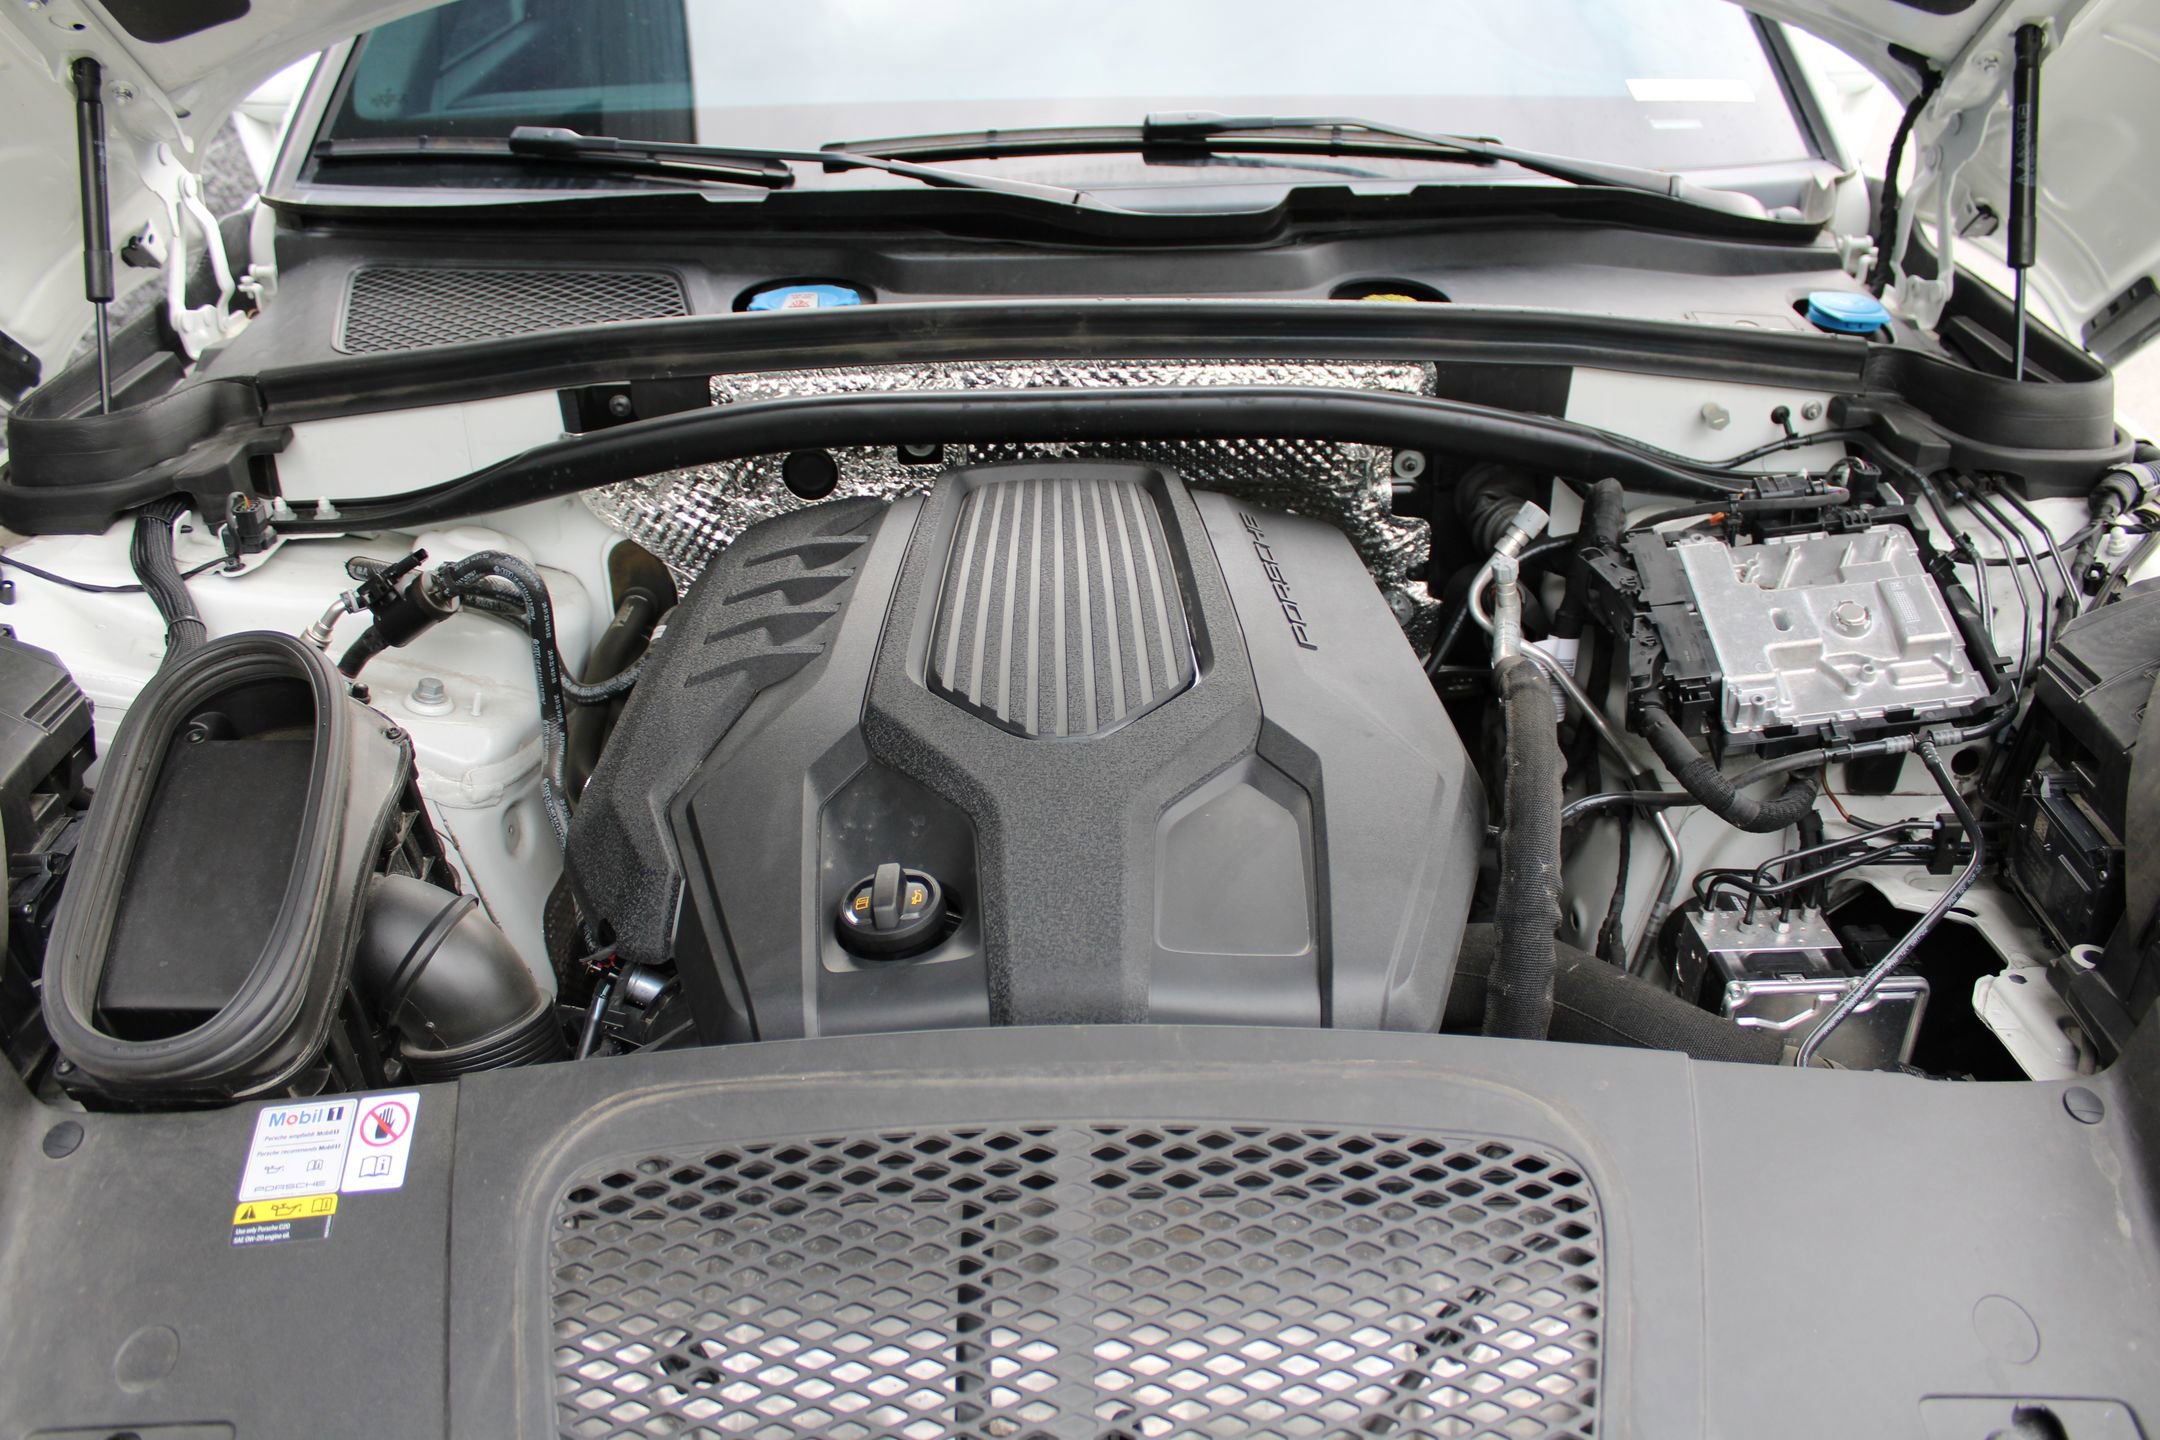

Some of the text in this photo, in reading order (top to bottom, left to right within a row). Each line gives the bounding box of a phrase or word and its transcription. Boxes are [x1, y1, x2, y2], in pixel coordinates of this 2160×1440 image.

[1239, 512, 1318, 651] PORSCHE
[268, 1109, 323, 1127] Mobil
[254, 1181, 326, 1192] PORSCHE
[257, 1224, 279, 1233] Porsche
